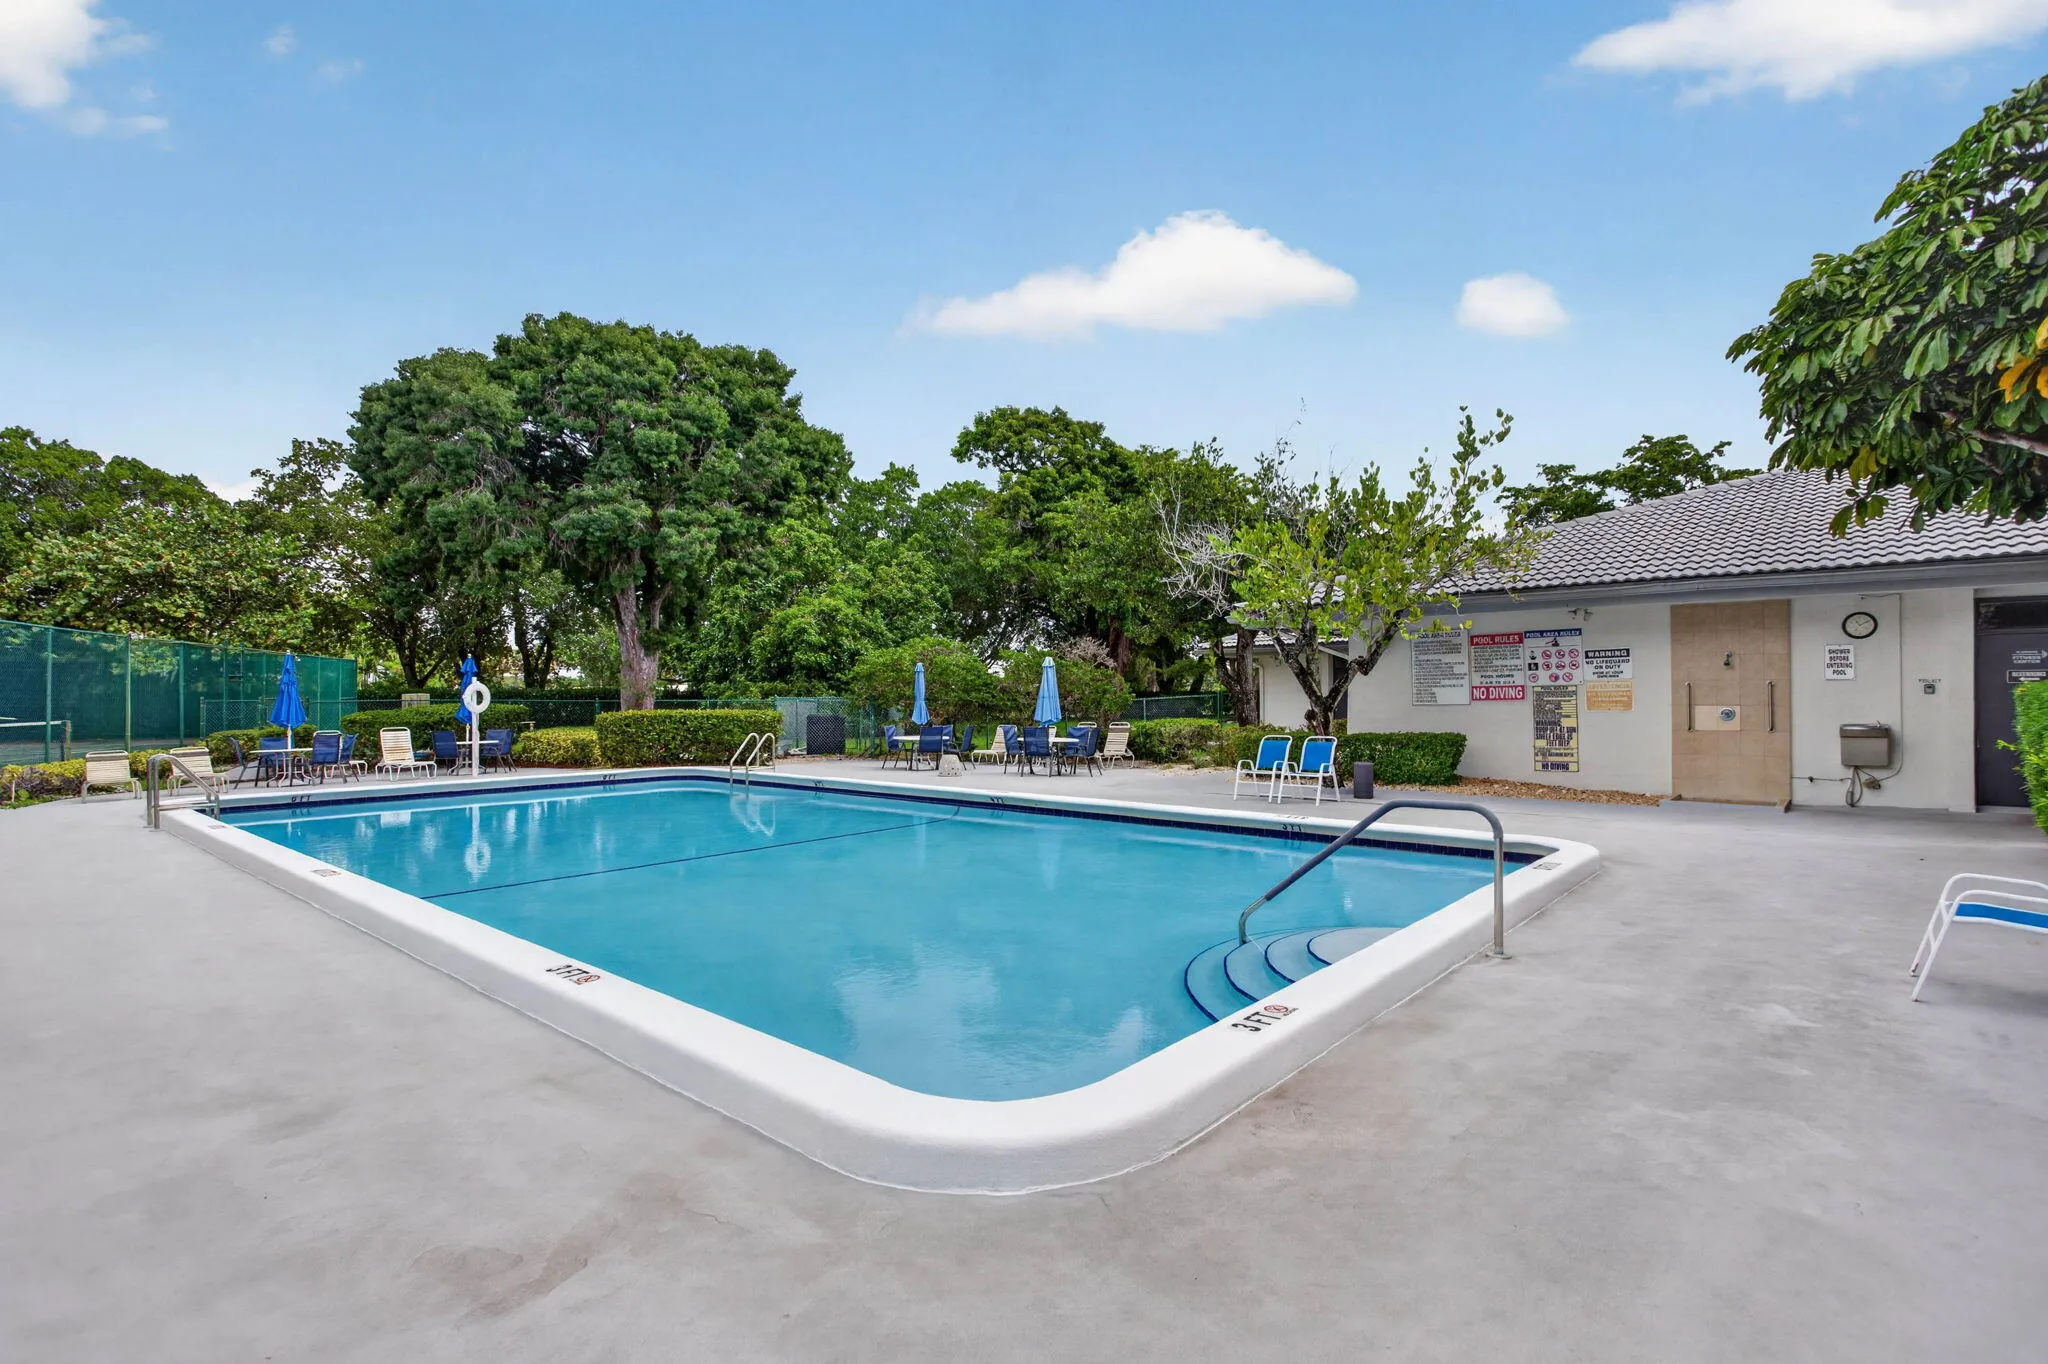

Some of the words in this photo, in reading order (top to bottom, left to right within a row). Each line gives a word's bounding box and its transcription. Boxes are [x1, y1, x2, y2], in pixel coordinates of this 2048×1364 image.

[1473, 636, 1493, 644] POOL
[1495, 635, 1520, 643] RULES
[1587, 650, 1628, 658] WARNING
[1473, 688, 1487, 700] NO
[1489, 686, 1523, 699] DIVING
[1541, 763, 1550, 771] NO
[1550, 762, 1570, 771] DIVING
[556, 968, 591, 979] FT
[1243, 1011, 1282, 1026] FT
[1231, 1023, 1262, 1032] 3
